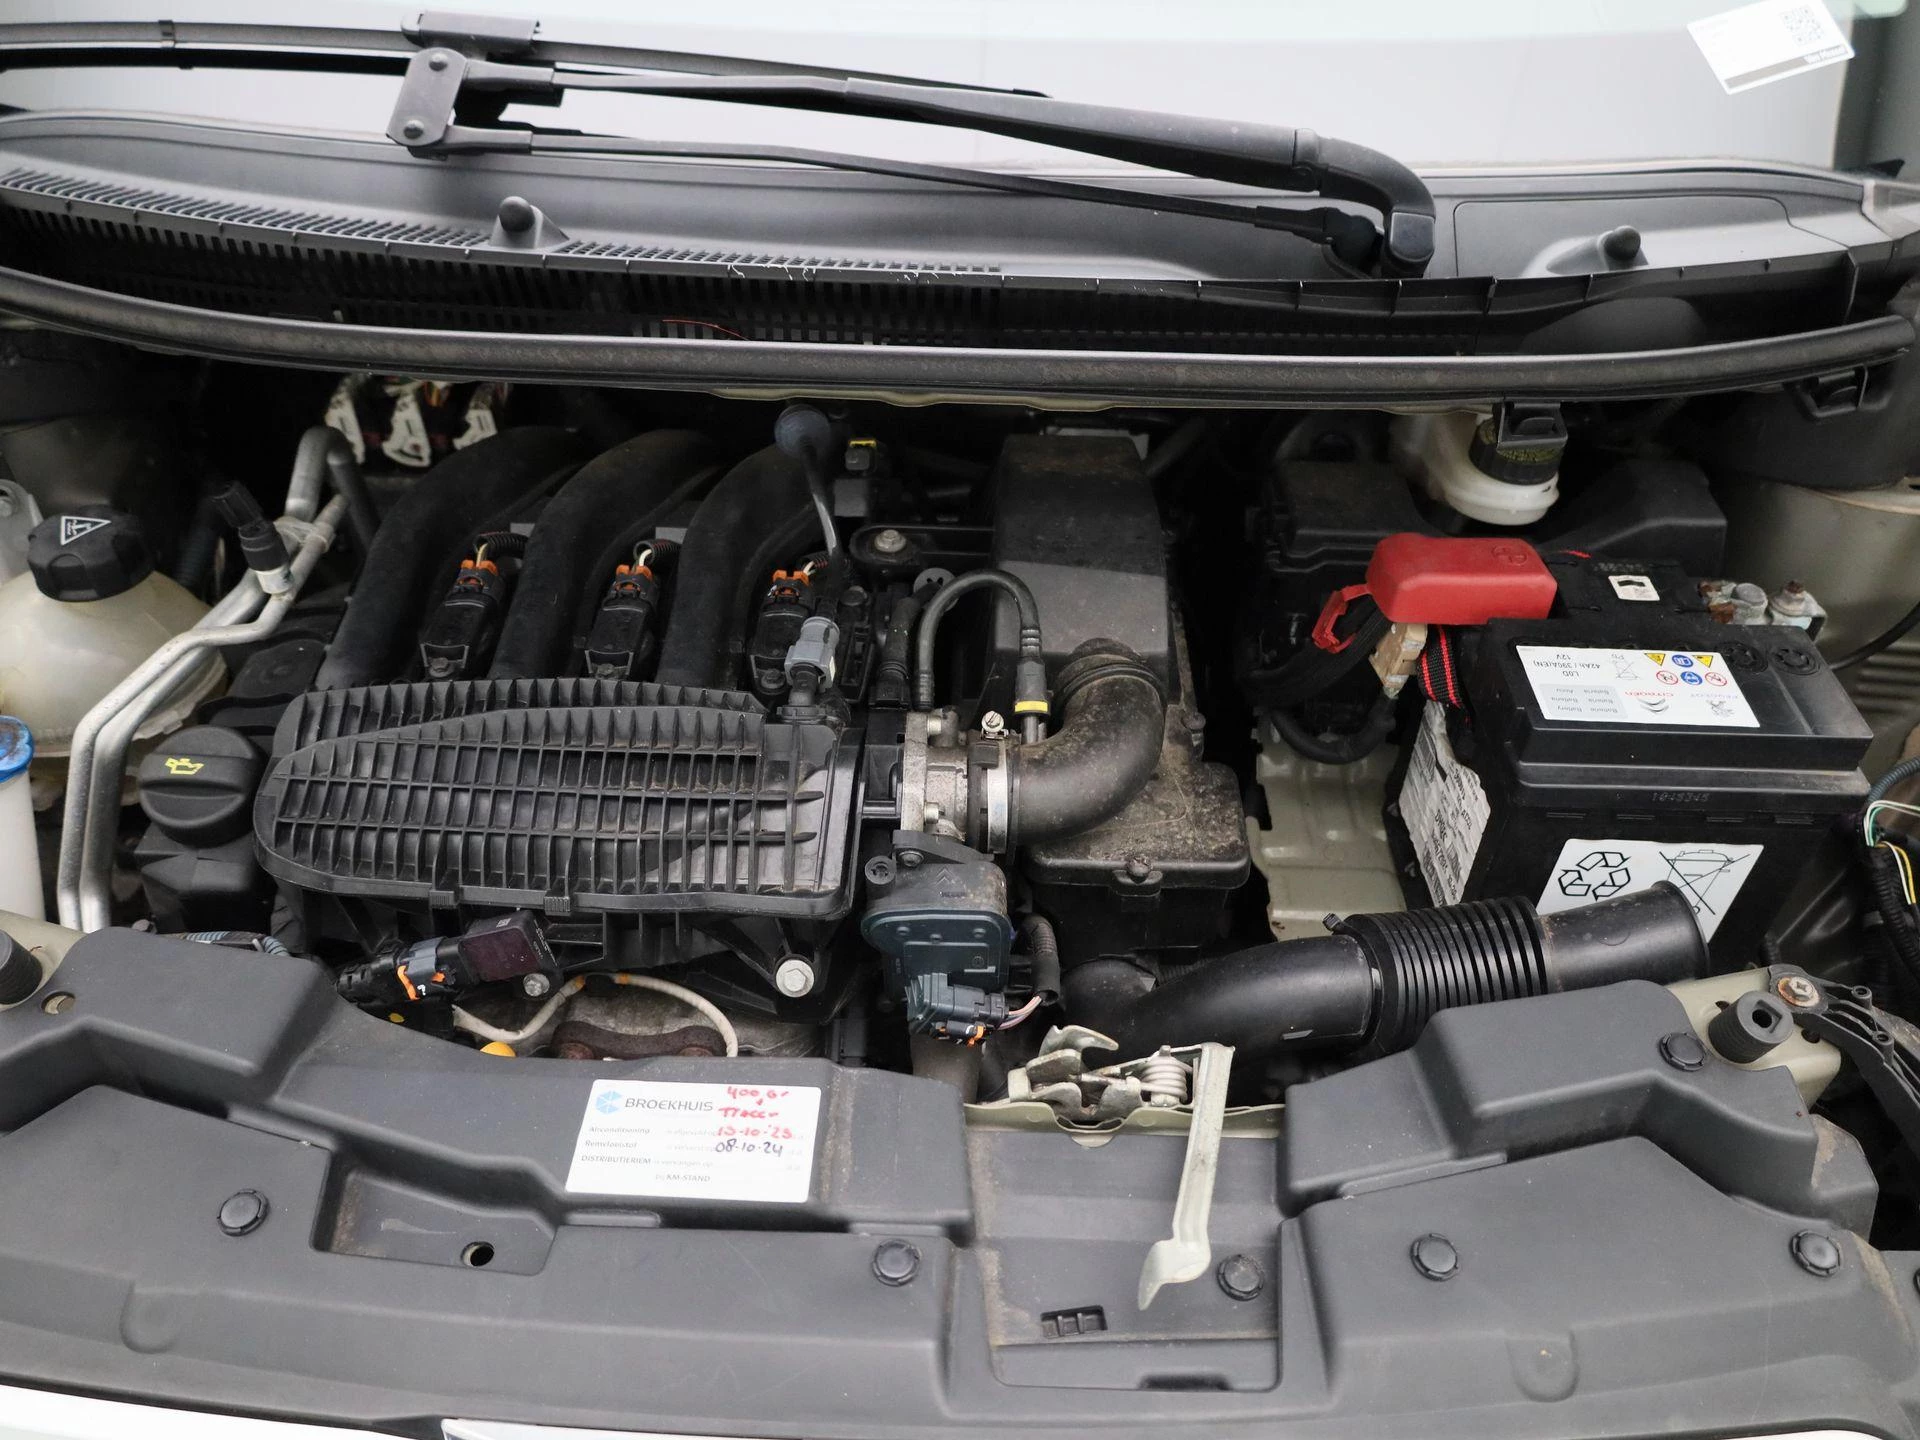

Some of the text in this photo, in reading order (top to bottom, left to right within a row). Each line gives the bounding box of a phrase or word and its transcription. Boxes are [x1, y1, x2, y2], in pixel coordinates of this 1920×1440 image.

[624, 1097, 714, 1112] BROEKHUIS
[581, 1154, 652, 1165] DISTRIBUTIERIEM
[666, 1174, 711, 1183] KM-STAND
